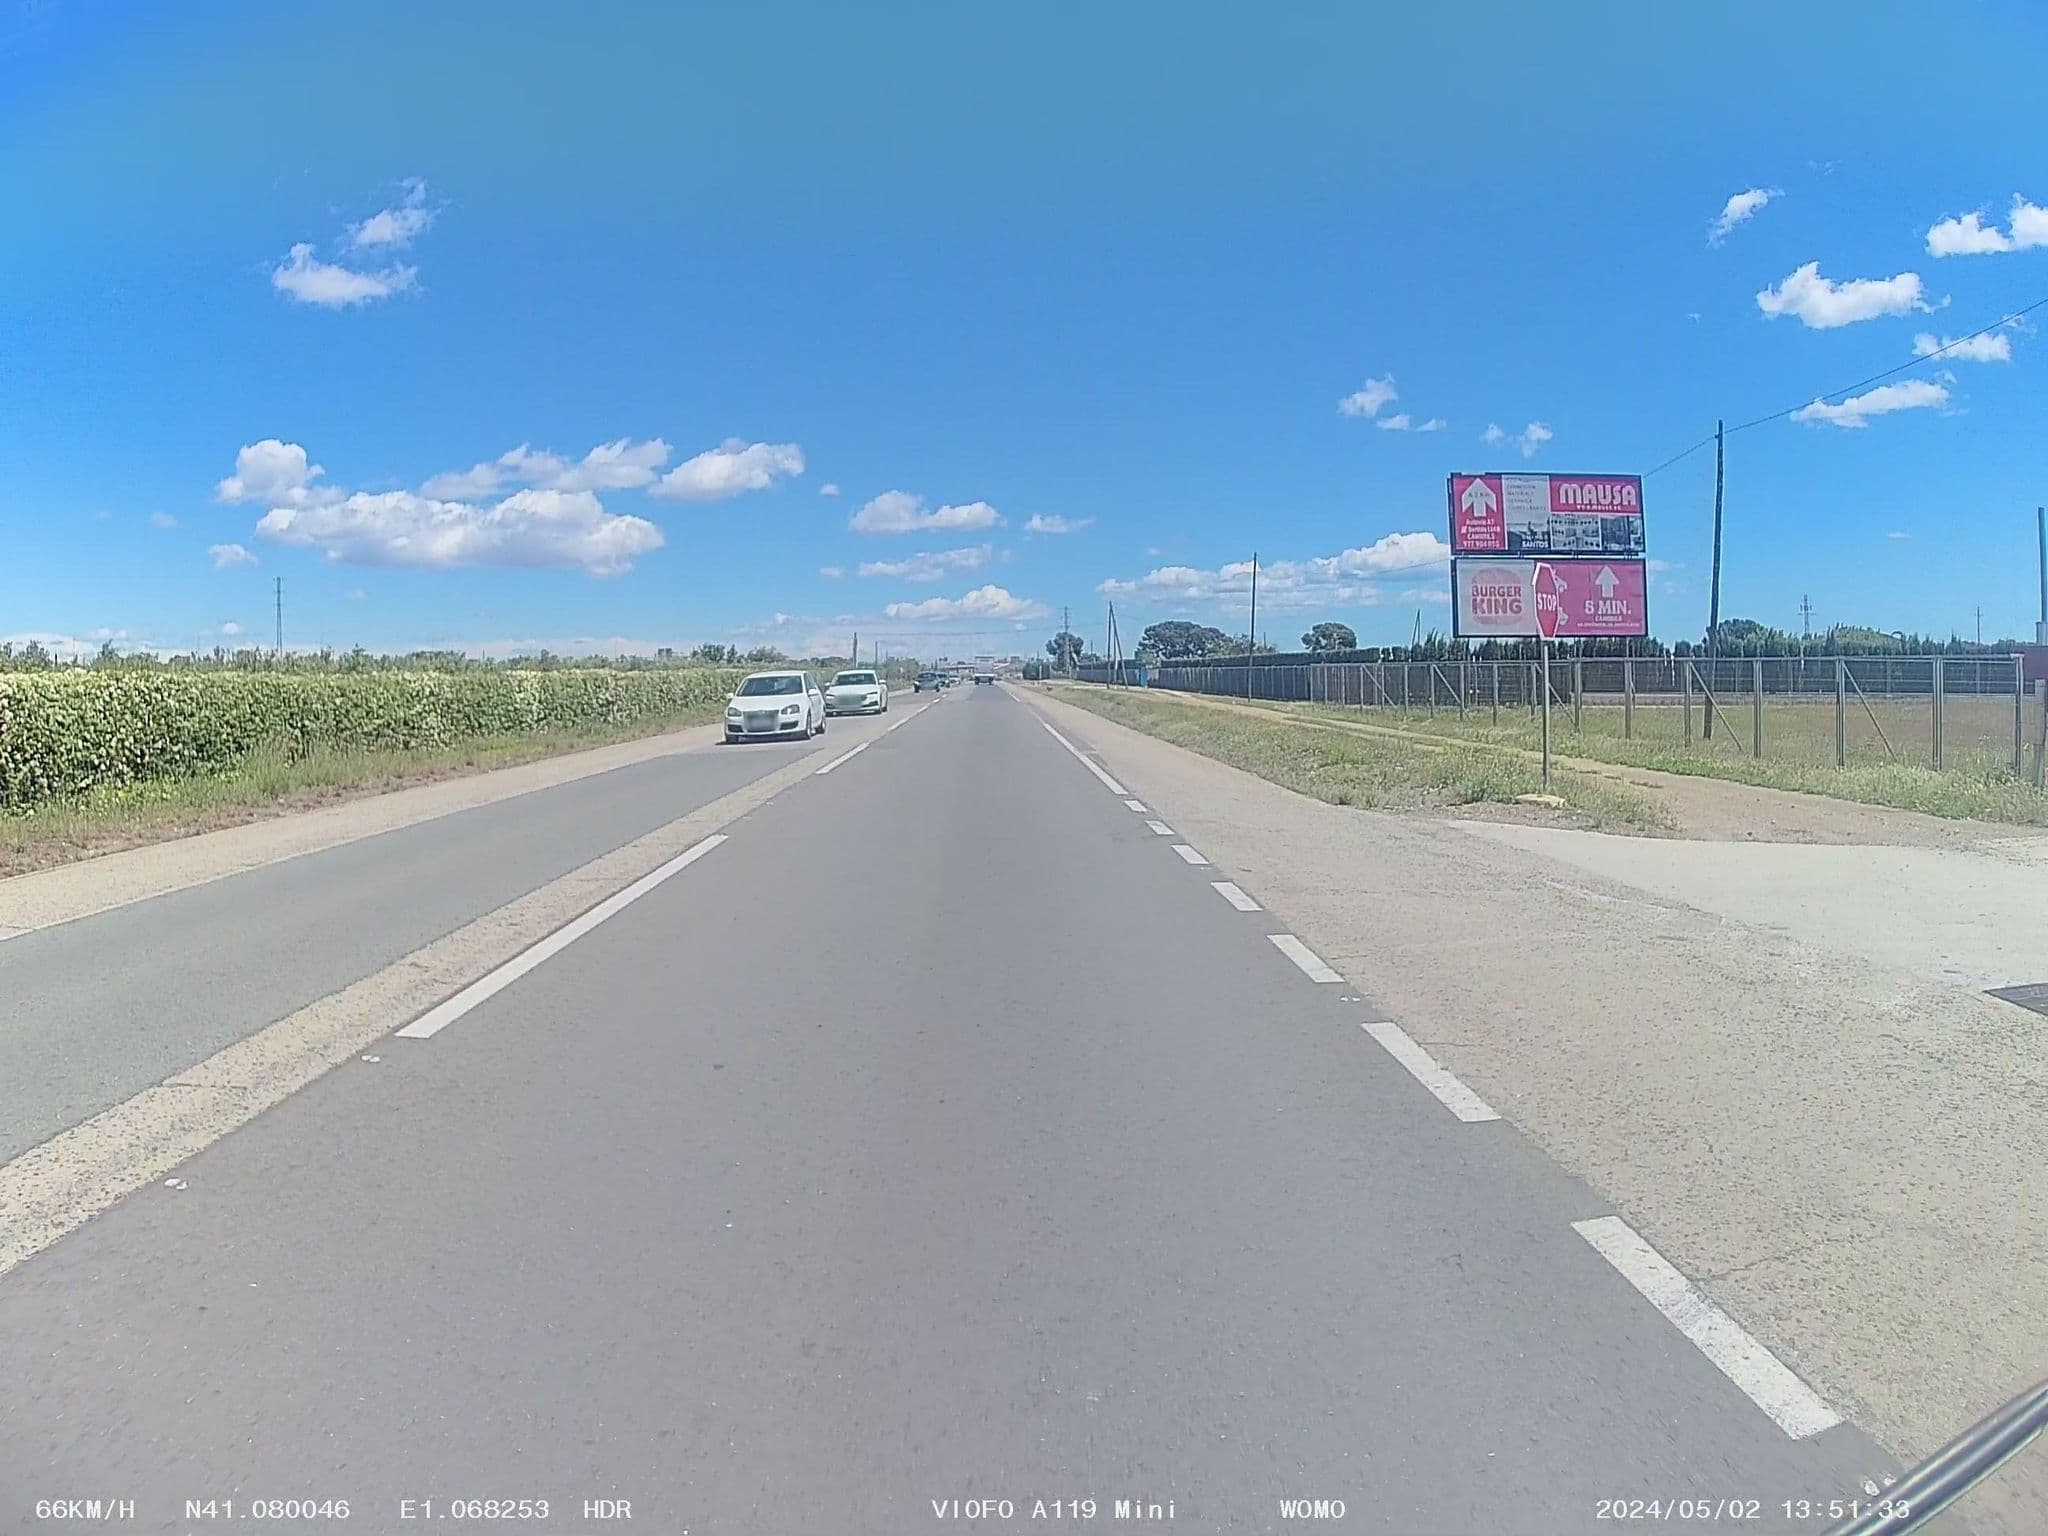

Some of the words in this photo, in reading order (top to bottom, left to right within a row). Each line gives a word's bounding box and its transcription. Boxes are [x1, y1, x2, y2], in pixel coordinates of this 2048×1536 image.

[1559, 484, 1637, 505] MAUSA
[1472, 585, 1521, 597] BURGER
[1472, 598, 1522, 614] KING
[1537, 592, 1558, 612] STOP
[1598, 600, 1631, 615] MIN.
